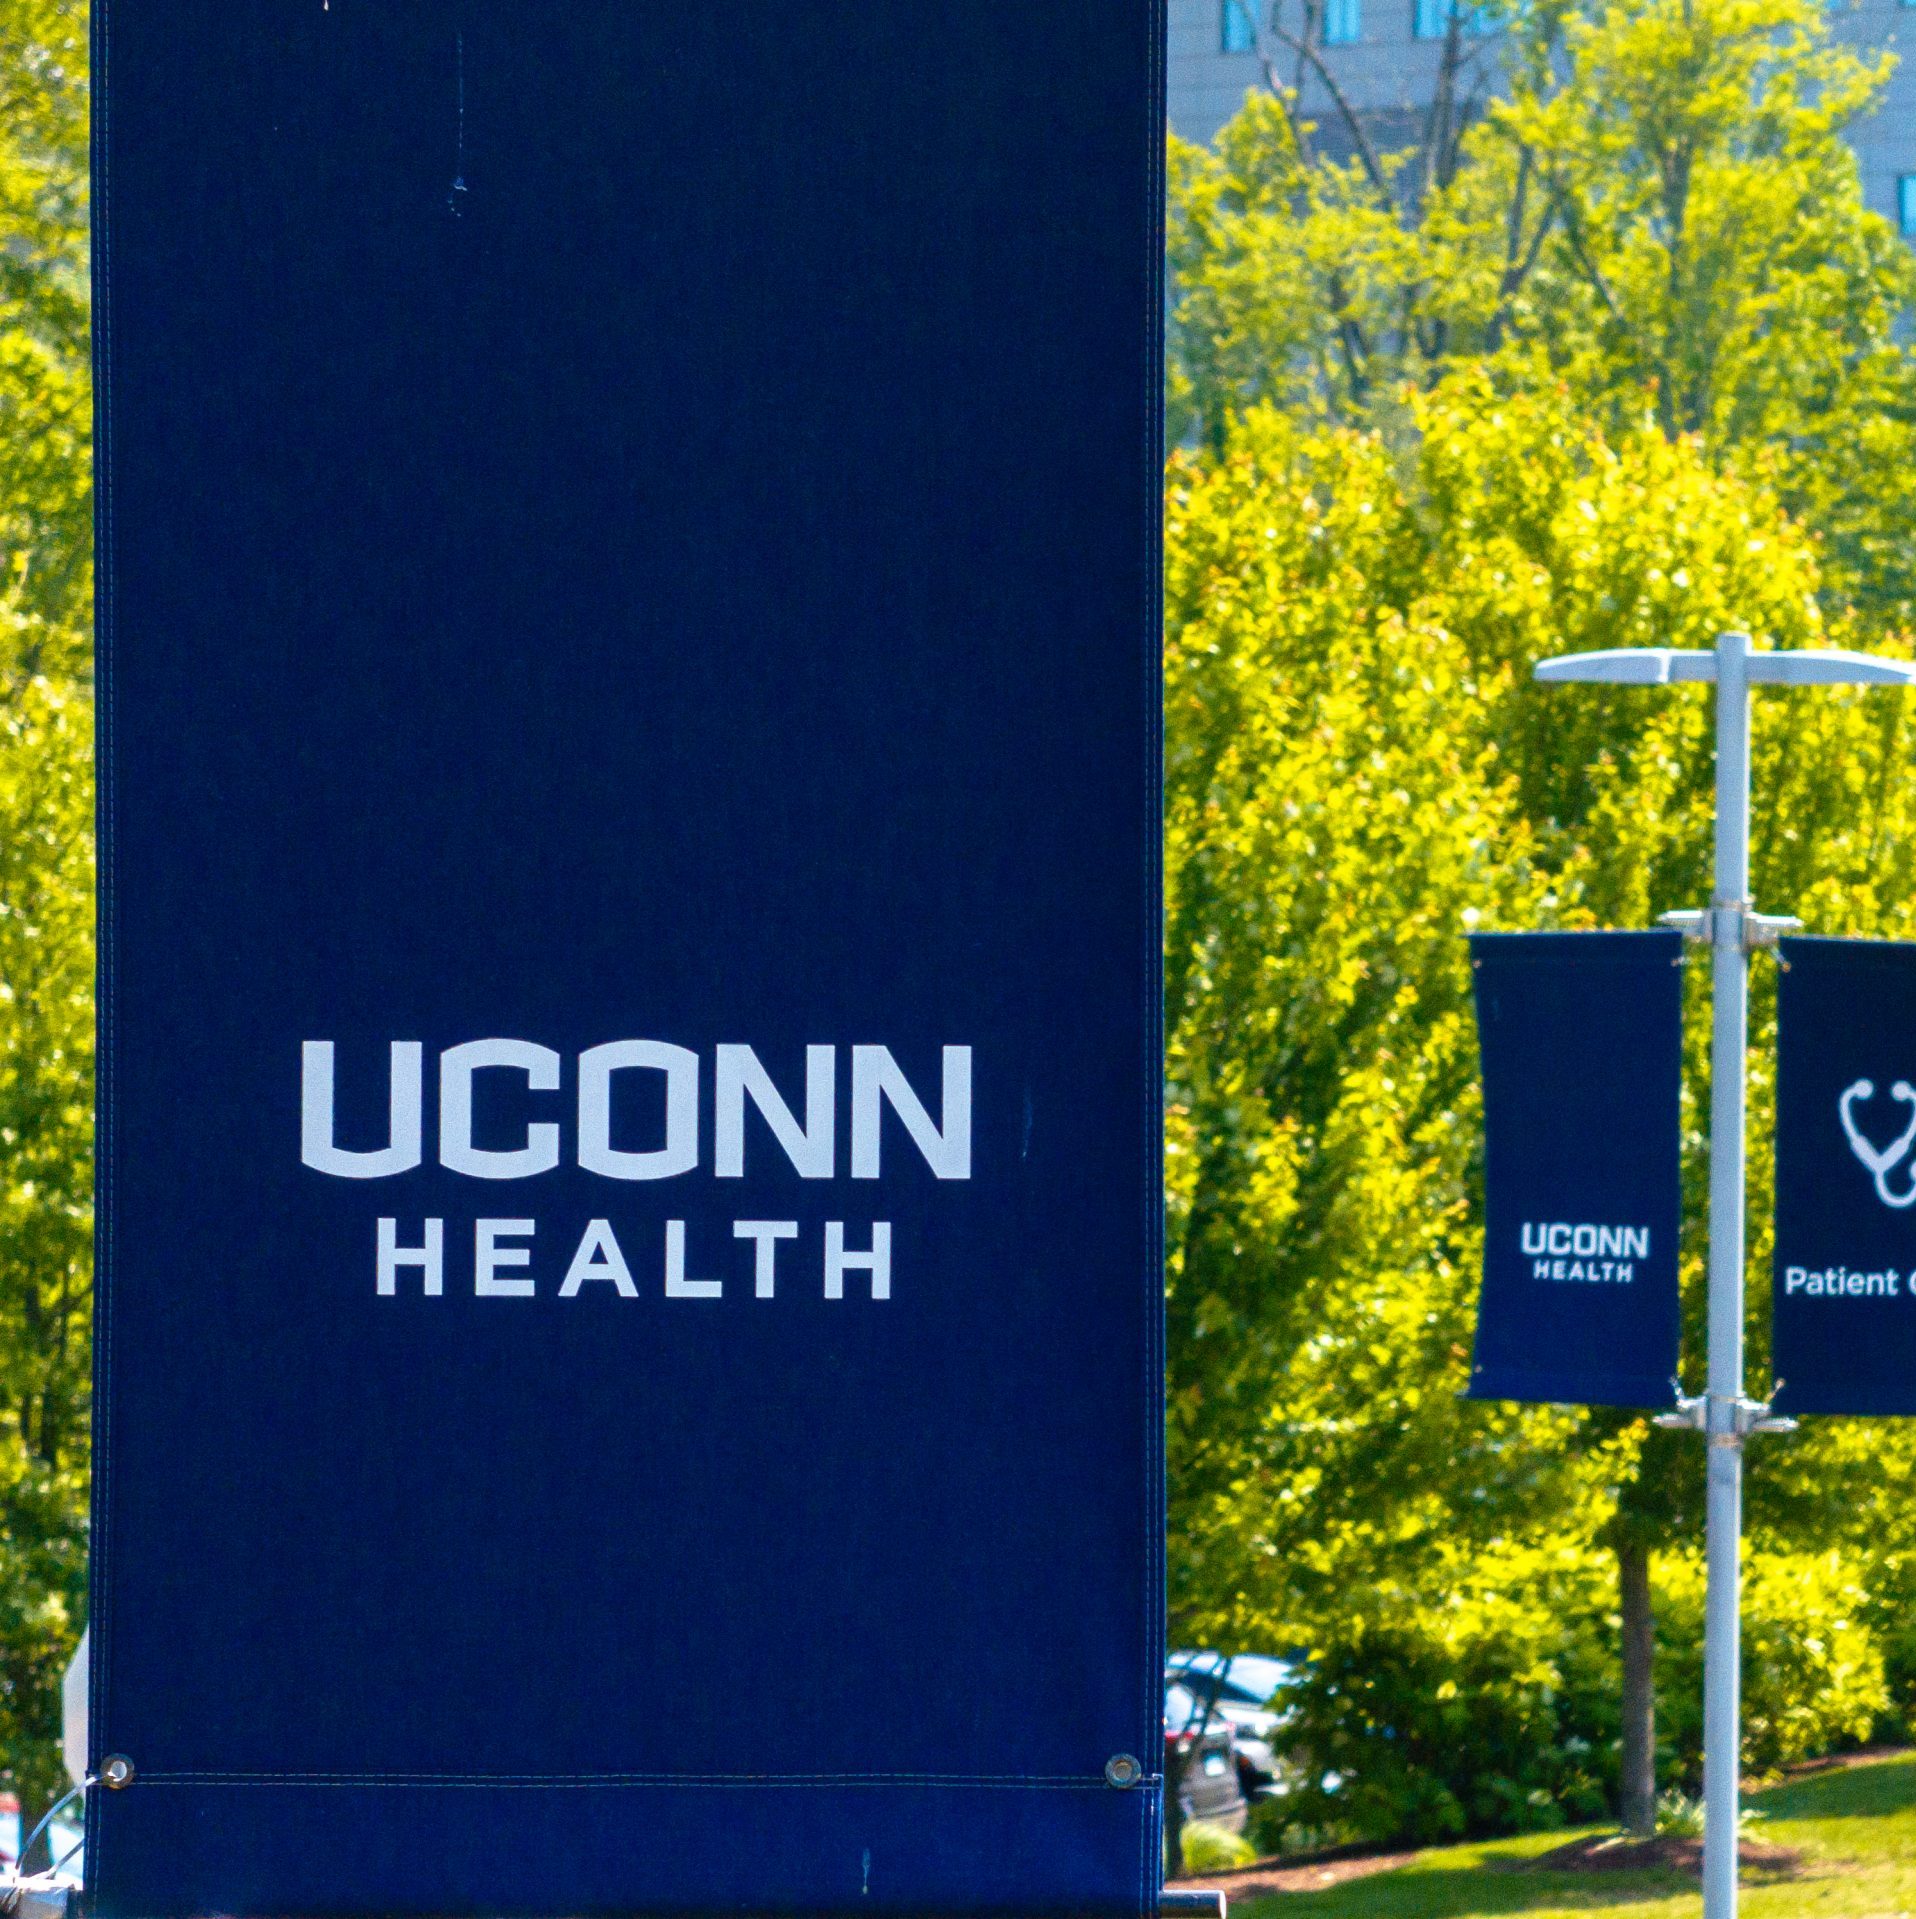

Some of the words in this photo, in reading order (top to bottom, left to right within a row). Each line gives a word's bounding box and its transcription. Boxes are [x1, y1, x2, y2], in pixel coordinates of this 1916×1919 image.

[301, 1037, 972, 1181] UCONN
[1521, 1222, 1649, 1258] UCONN
[376, 1217, 892, 1300] HEALTH
[1533, 1260, 1633, 1283] HEALTH
[1785, 1265, 1899, 1296] Patient
